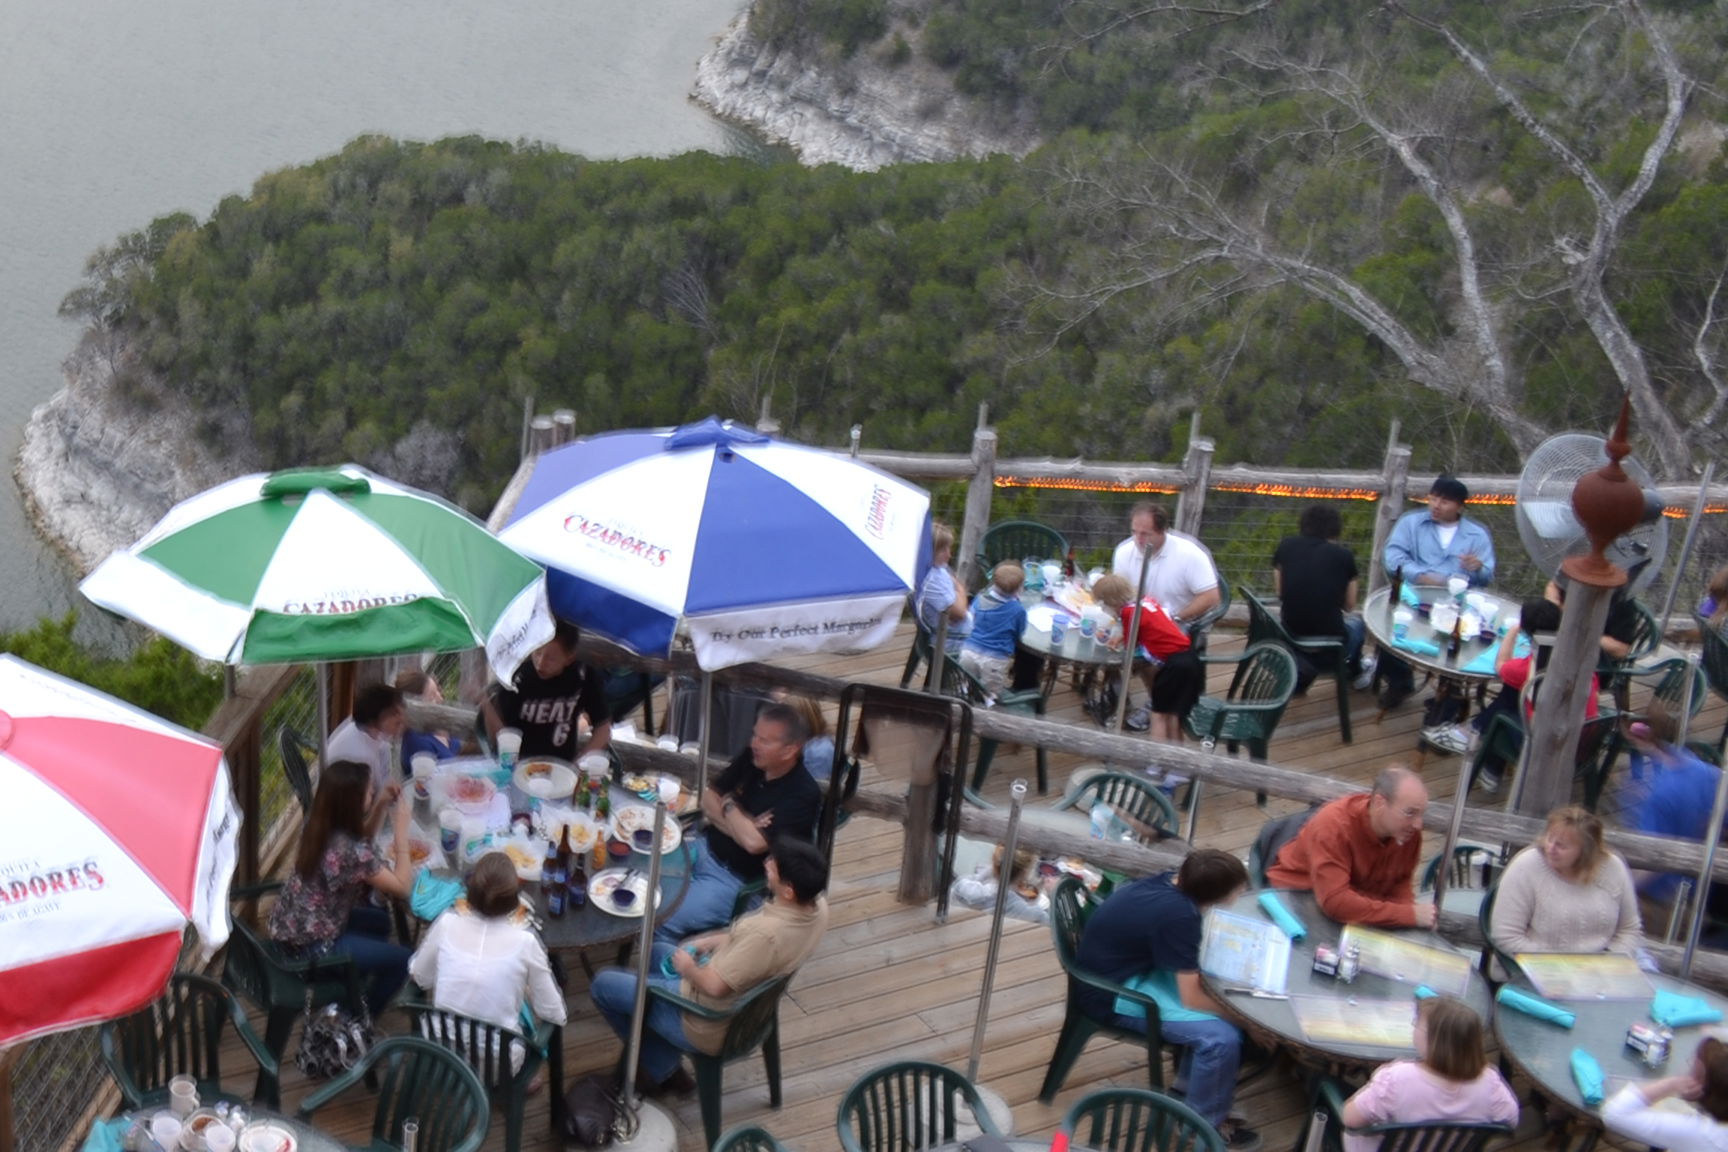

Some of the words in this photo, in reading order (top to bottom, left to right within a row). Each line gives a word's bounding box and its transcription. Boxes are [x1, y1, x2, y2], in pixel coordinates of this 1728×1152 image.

[563, 513, 672, 567] CAZADORES
[738, 629, 764, 640] Our
[771, 623, 819, 639] Perfect
[520, 695, 580, 724] HEAT
[553, 723, 570, 746] 6
